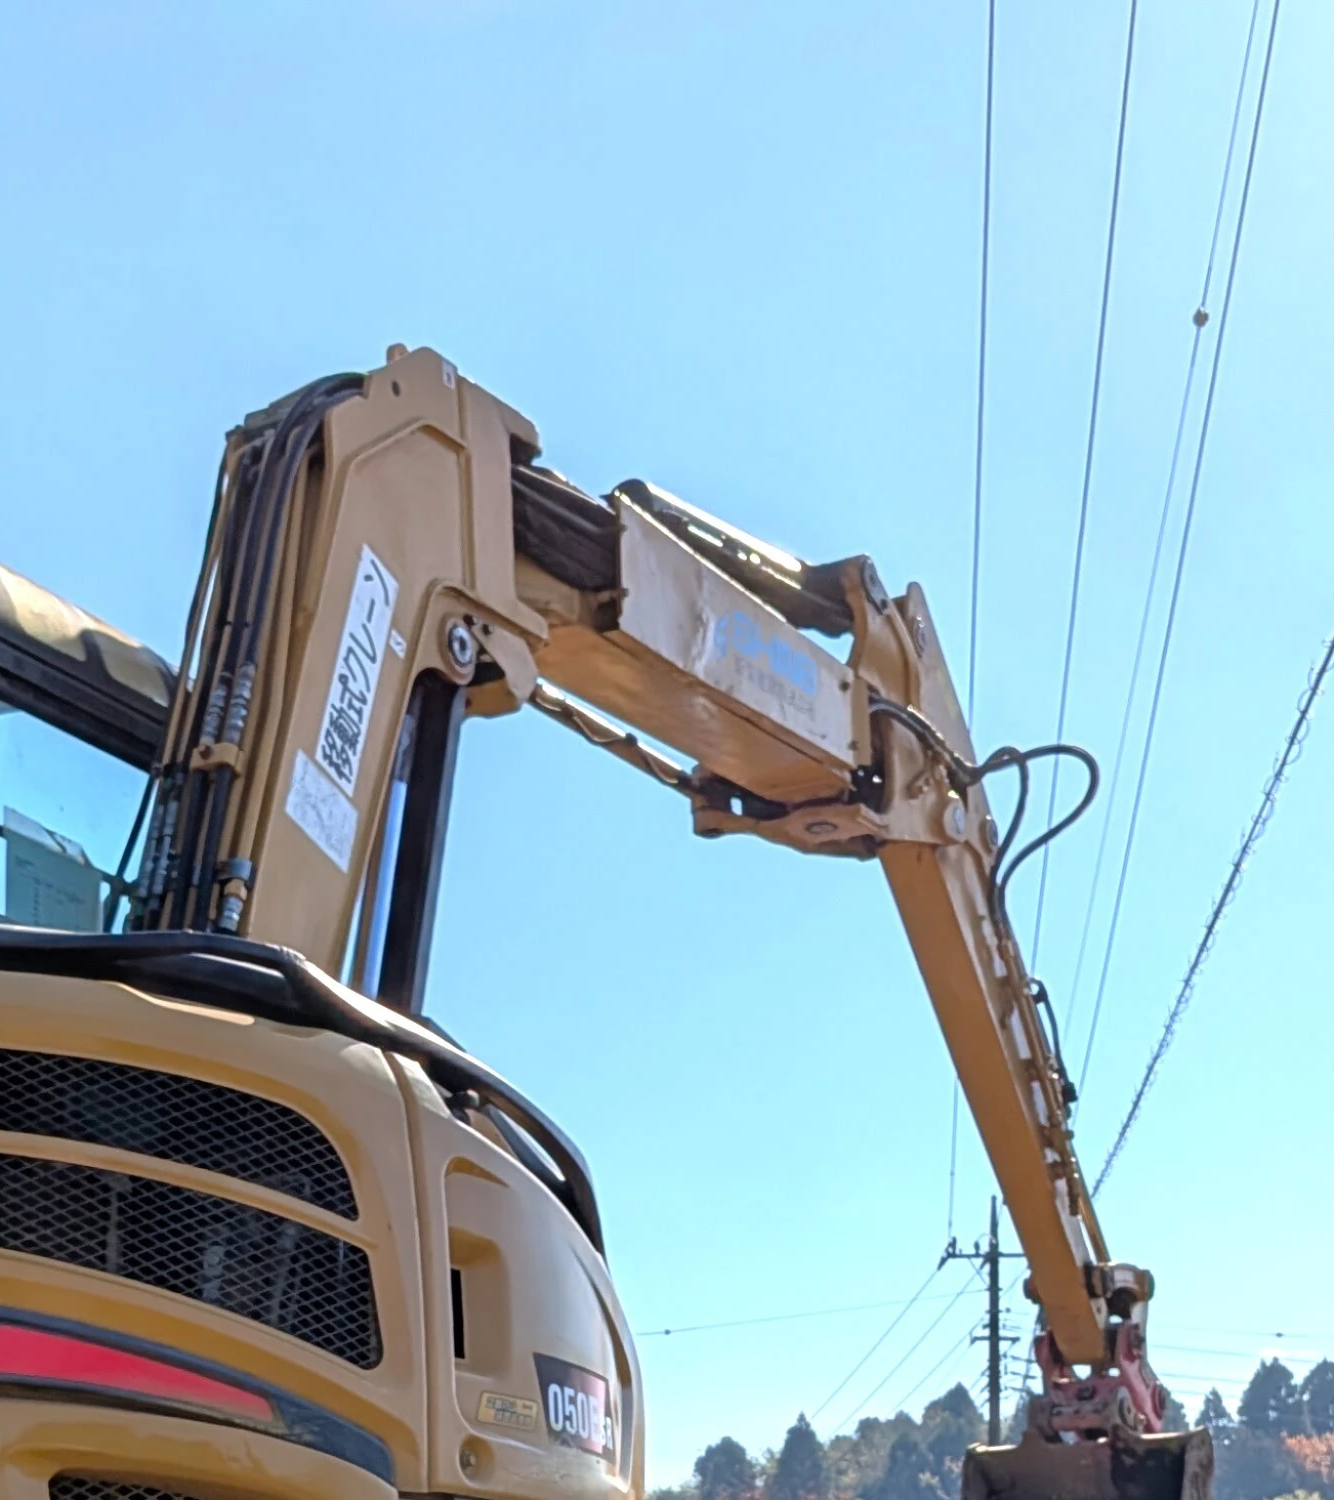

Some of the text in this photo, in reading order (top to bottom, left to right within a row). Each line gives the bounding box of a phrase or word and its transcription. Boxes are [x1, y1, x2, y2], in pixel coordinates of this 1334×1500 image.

[320, 559, 391, 785] 移動式クレーン
